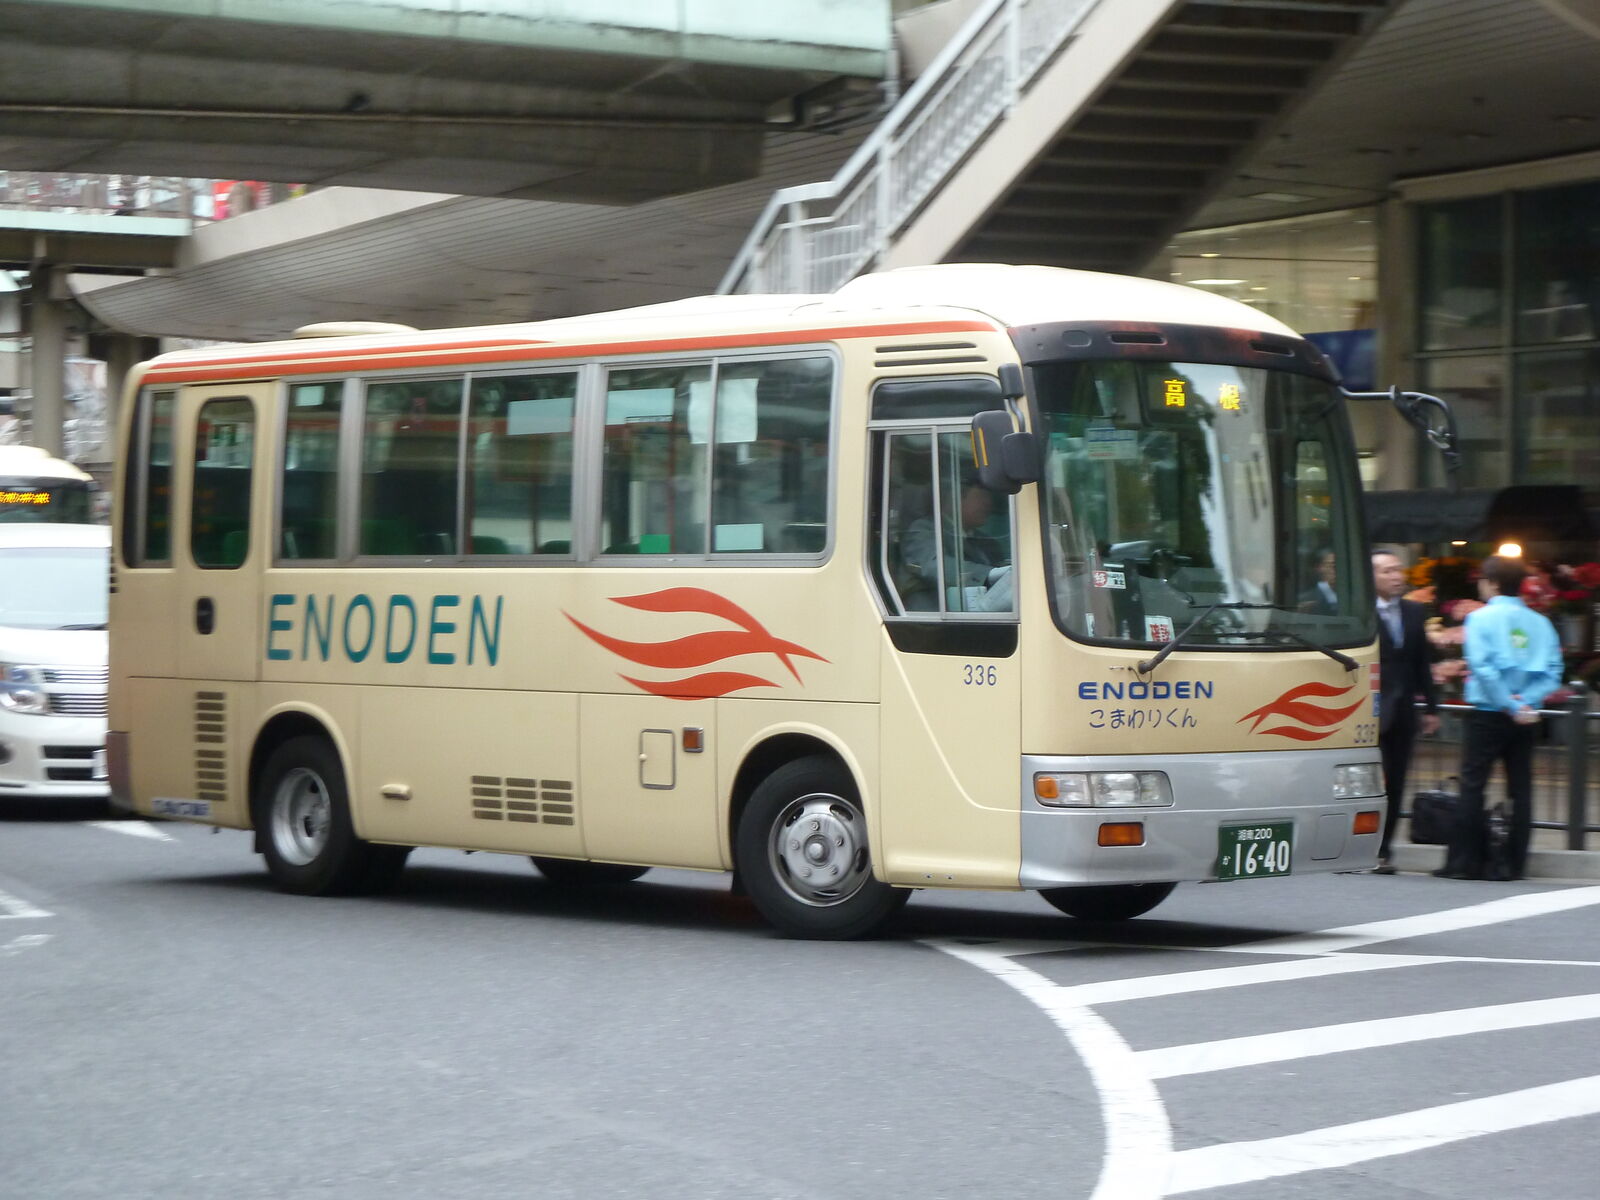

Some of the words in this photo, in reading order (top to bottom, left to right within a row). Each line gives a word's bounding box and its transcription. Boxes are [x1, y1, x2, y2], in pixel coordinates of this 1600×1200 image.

[267, 593, 504, 666] ENODEN
[963, 664, 997, 686] 336
[1078, 681, 1213, 700] ENODEN
[1089, 708, 1198, 729] こまわりくん
[1235, 840, 1290, 875] 16-40
